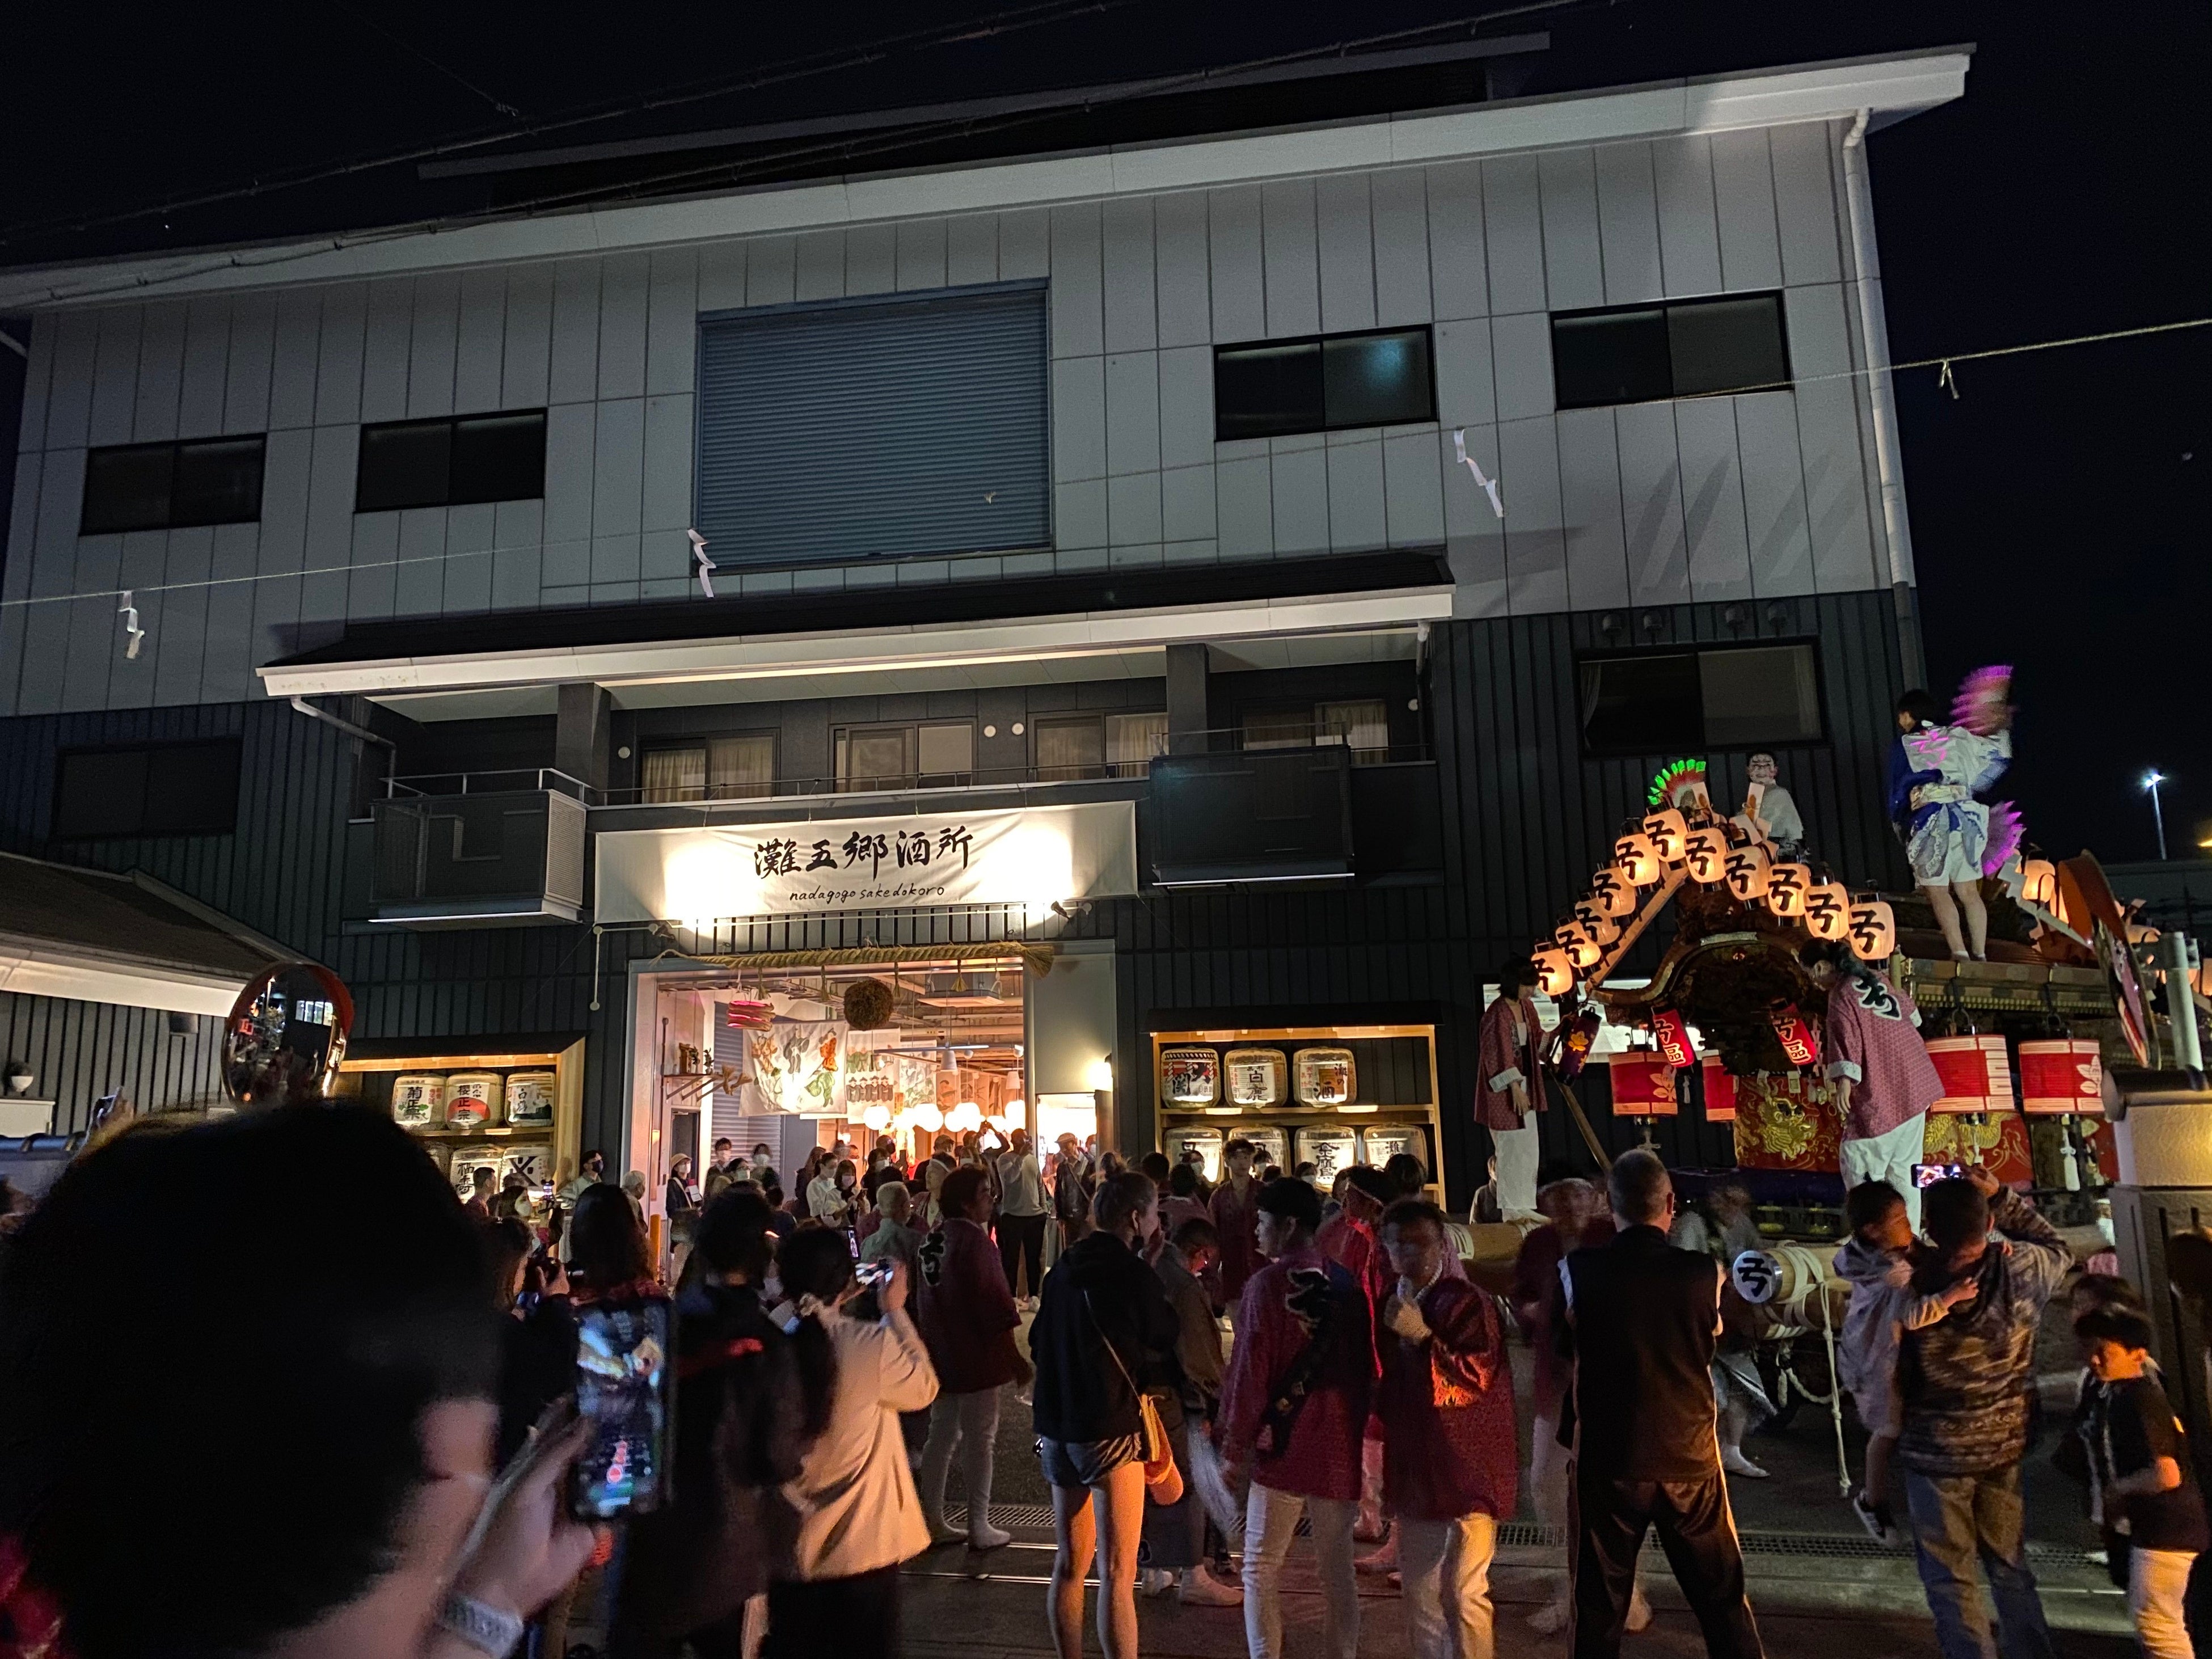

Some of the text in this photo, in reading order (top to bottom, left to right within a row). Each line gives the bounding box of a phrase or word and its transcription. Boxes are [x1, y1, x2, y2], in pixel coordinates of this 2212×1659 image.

[754, 825, 973, 881] 灘五郷酒所
[790, 883, 944, 904] nadagogo sakedokoro
[406, 1086, 423, 1120] 菊正宗
